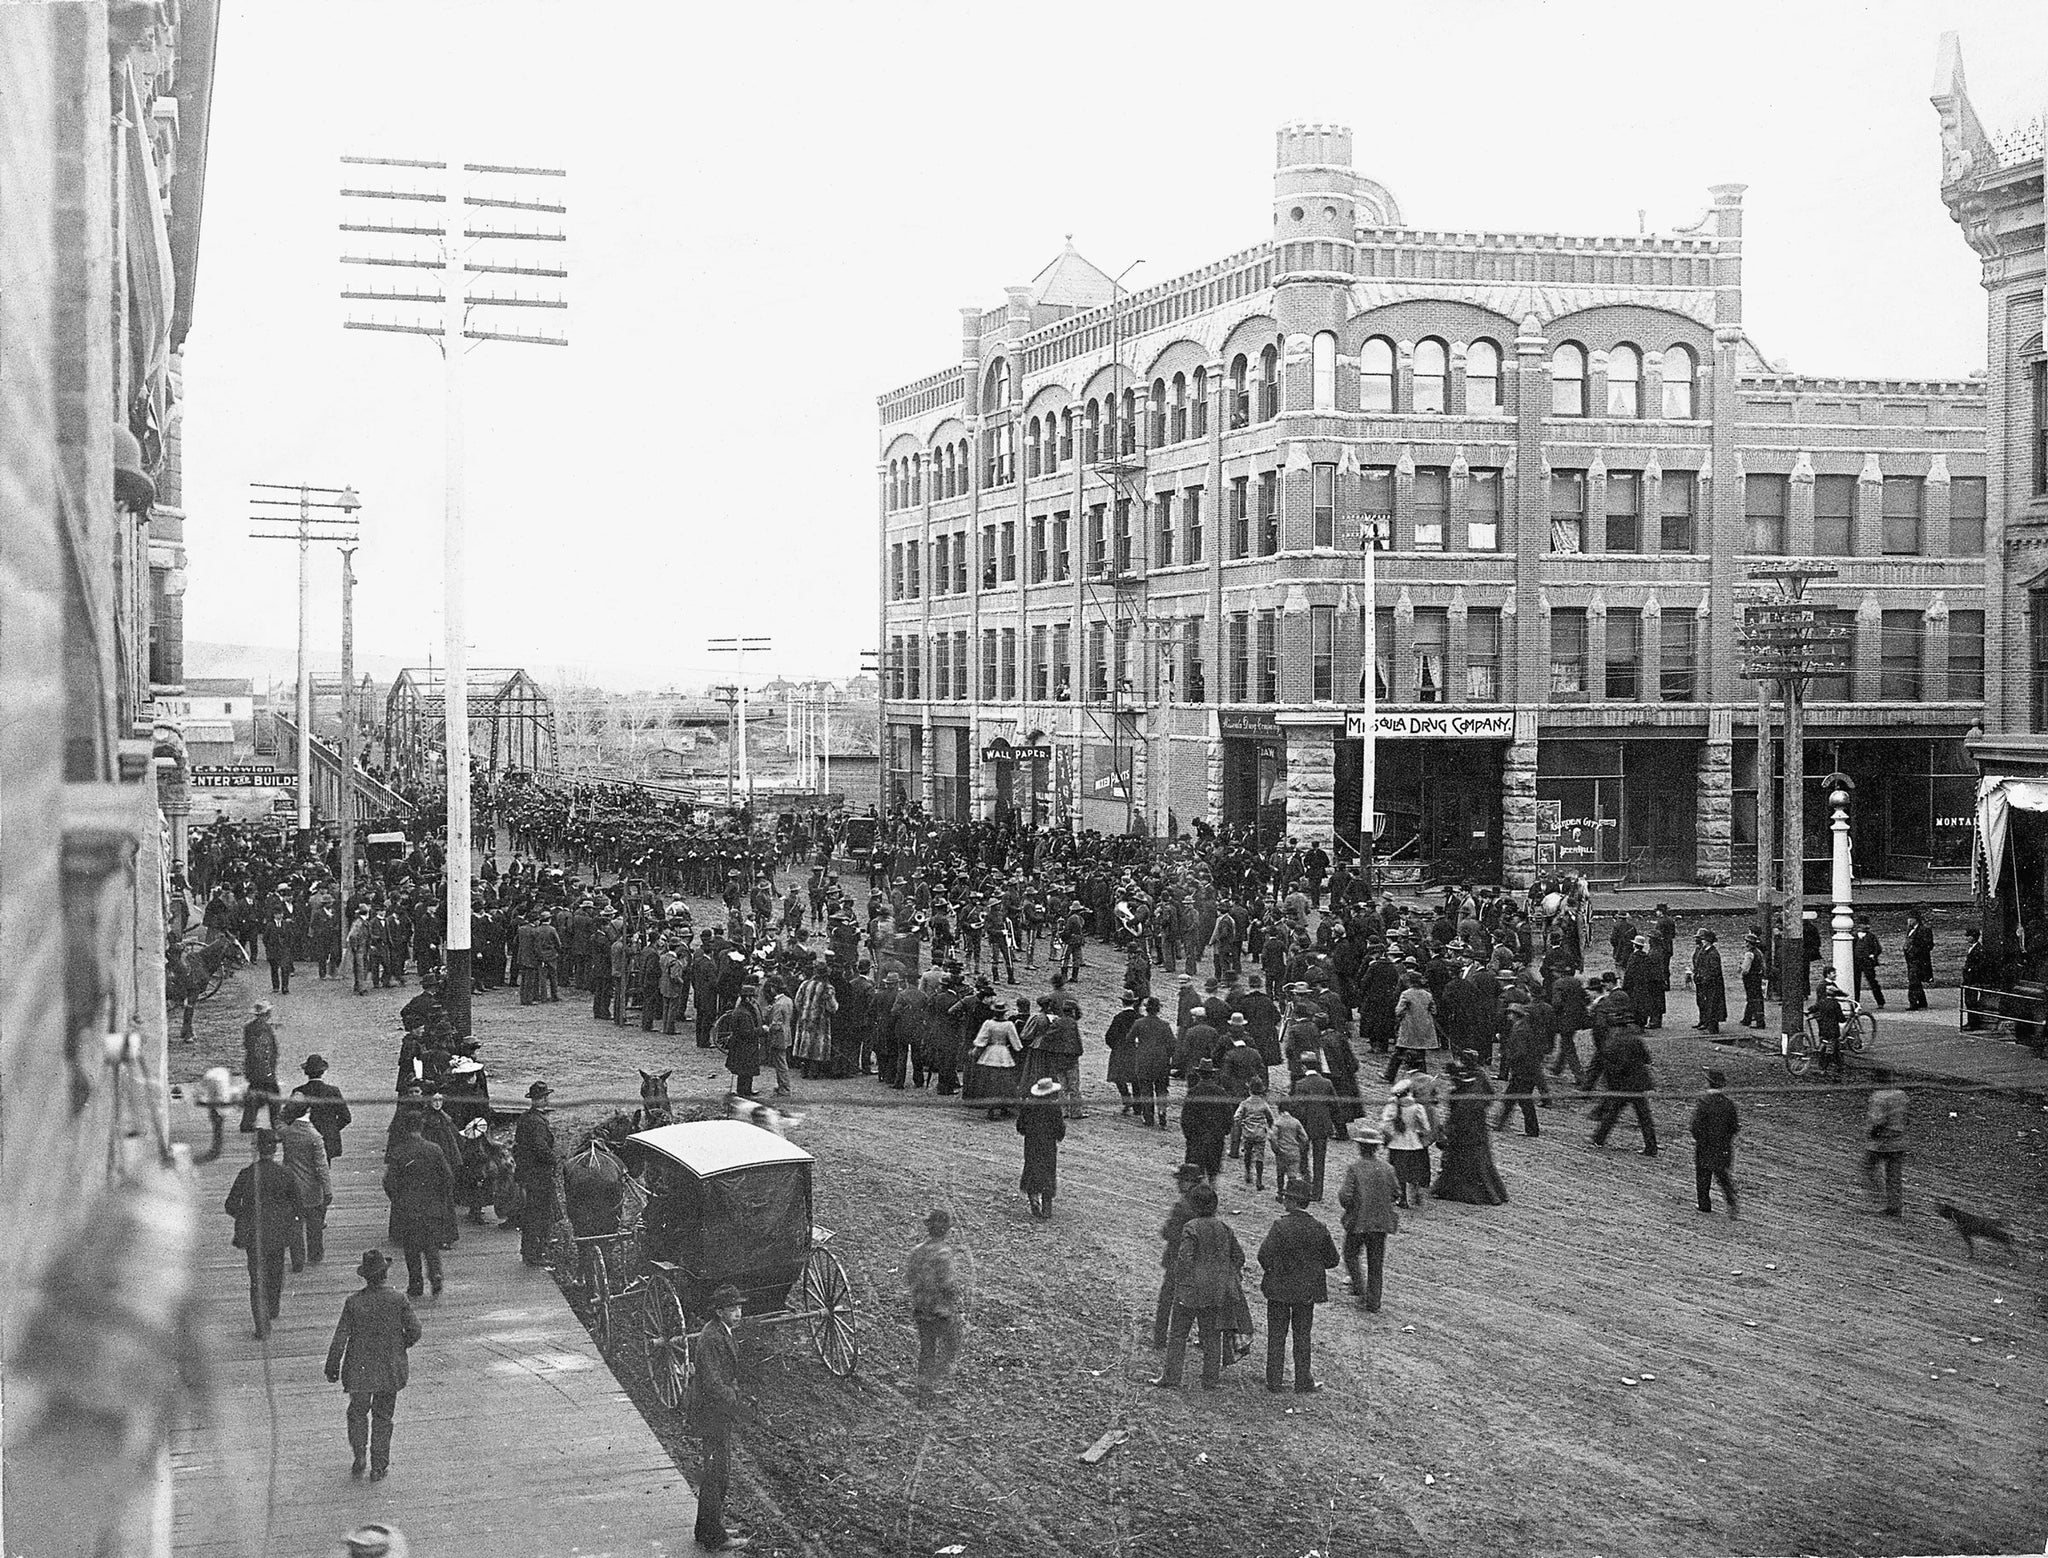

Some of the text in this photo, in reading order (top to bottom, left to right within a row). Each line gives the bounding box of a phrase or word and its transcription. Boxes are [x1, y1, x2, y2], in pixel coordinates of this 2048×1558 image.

[1348, 717, 1512, 735] MISOULA DRUG COMPANY.
[986, 749, 1011, 760] WALL
[253, 775, 298, 786] BUILDE
[1582, 816, 1602, 830] CITY
